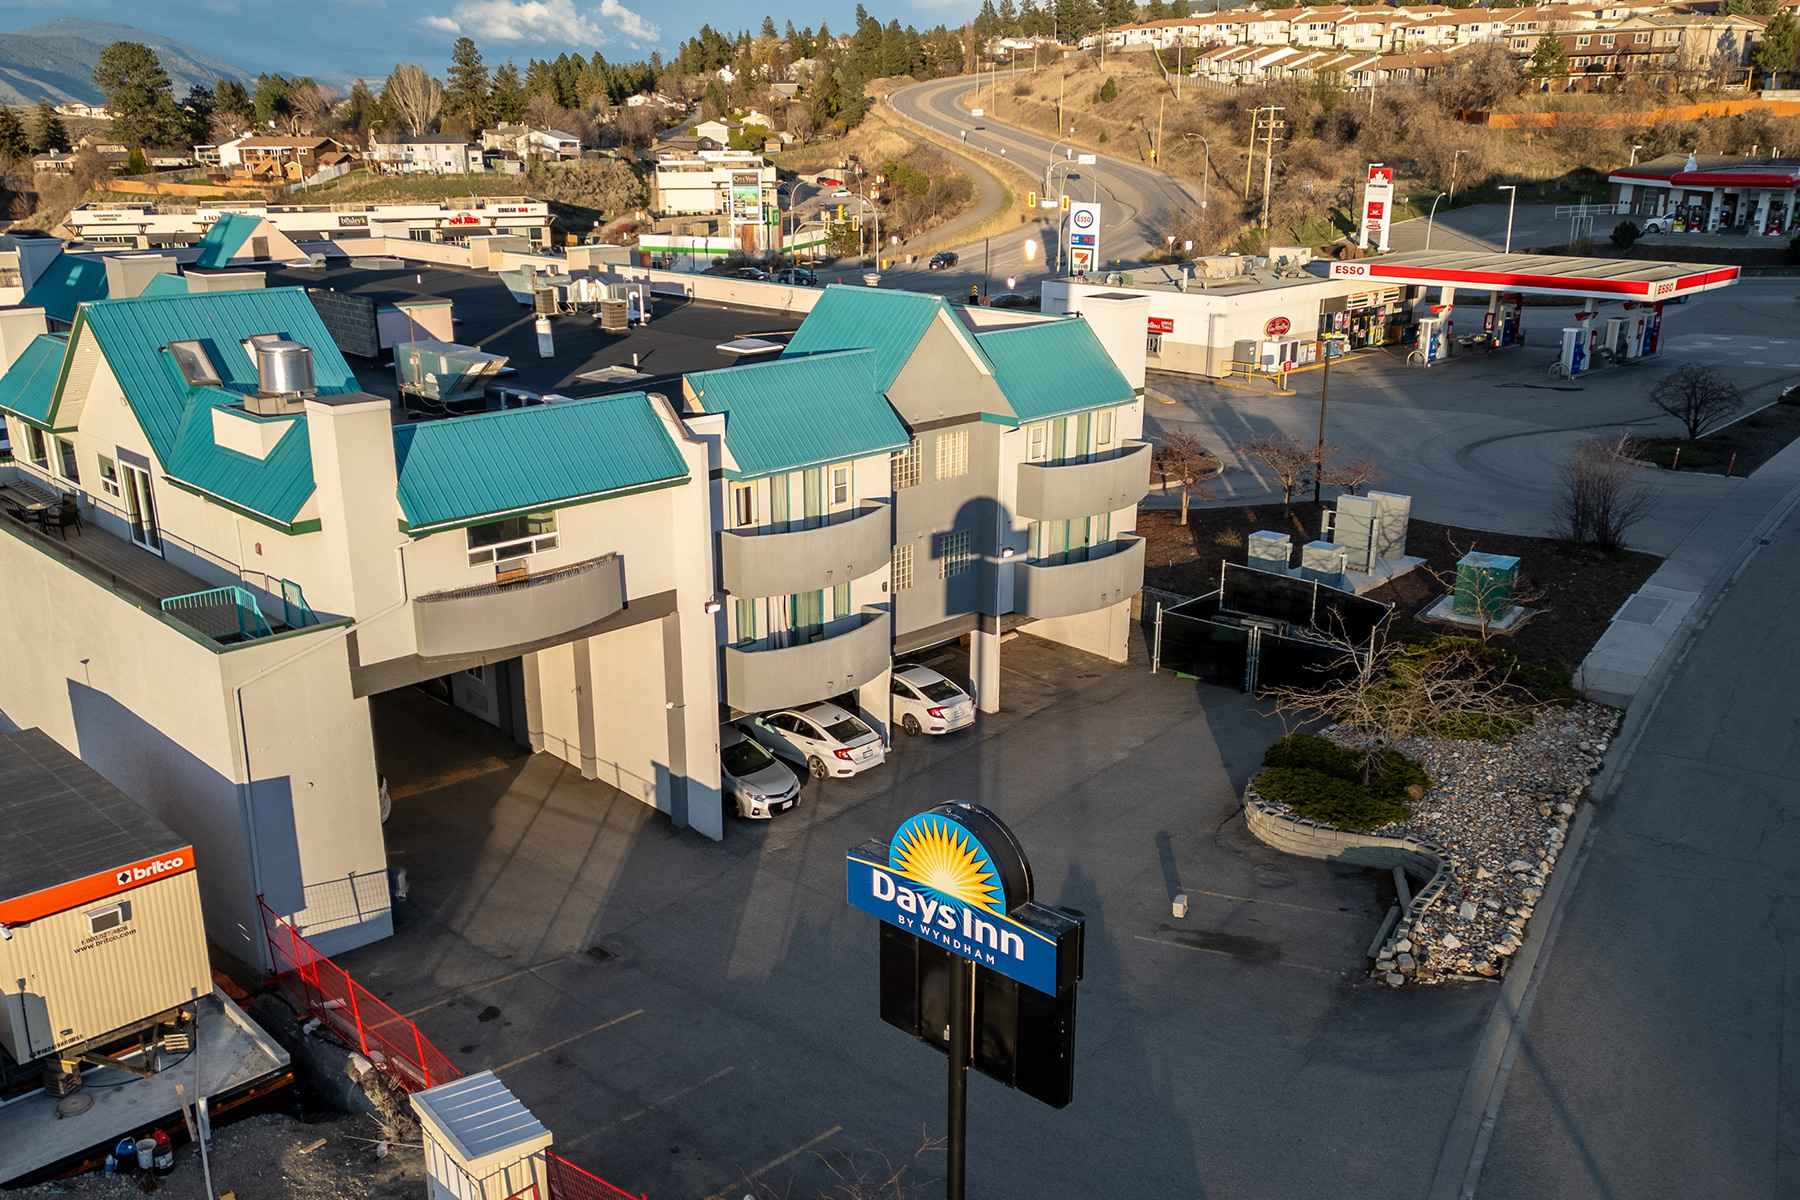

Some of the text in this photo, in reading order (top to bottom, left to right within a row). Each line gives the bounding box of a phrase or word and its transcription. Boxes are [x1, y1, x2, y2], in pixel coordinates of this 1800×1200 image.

[1075, 252, 1088, 264] 7
[1335, 265, 1365, 275] ESSO
[1657, 283, 1674, 295] ESSO
[133, 857, 184, 881] britco
[872, 868, 1025, 962] Days Inn
[73, 927, 137, 954] www.britco.com
[898, 914, 995, 965] BY WYNDHAM
